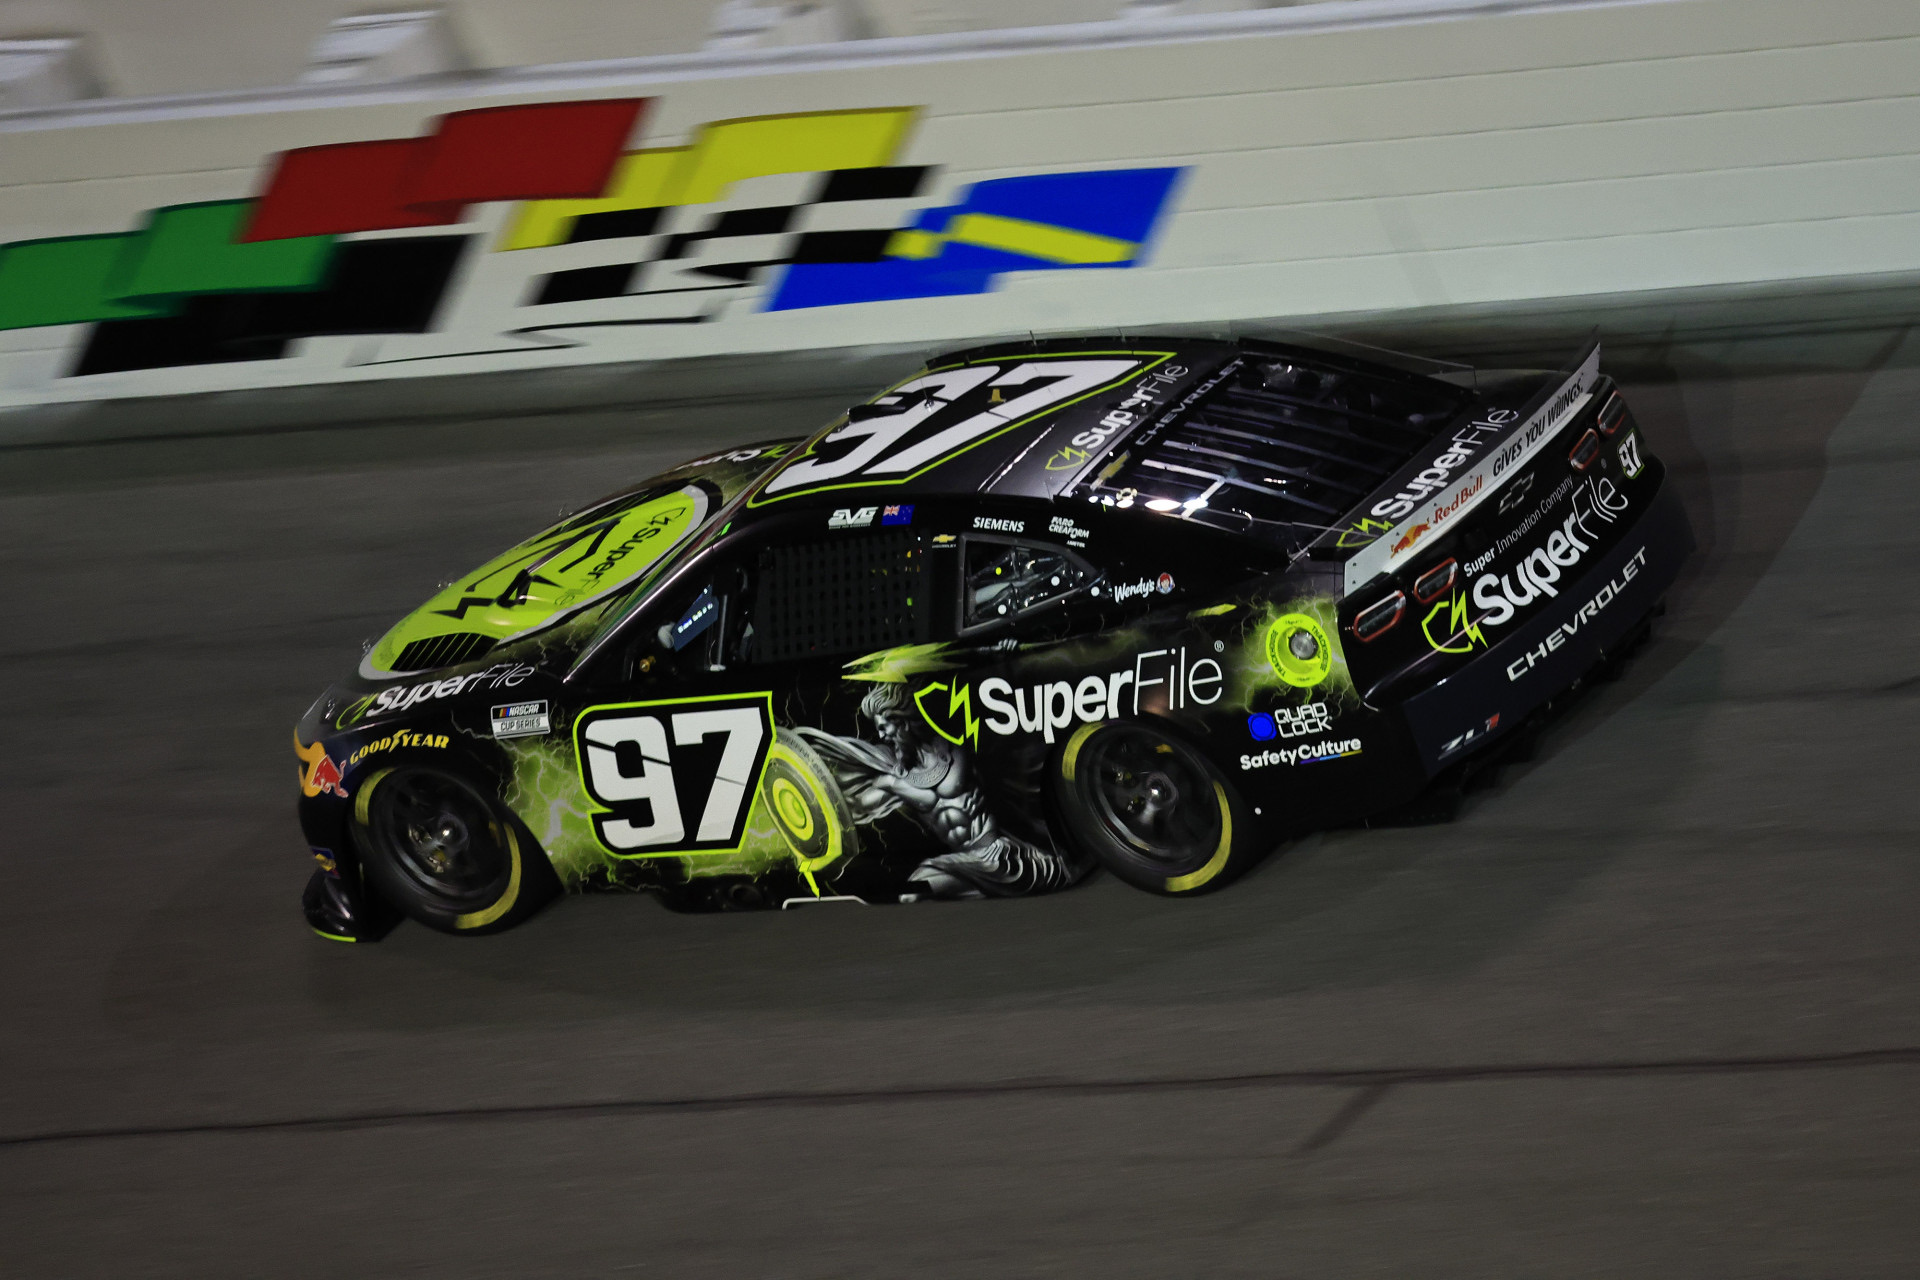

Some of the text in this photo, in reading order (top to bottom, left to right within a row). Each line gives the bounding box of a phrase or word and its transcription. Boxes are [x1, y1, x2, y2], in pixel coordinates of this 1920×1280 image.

[1072, 365, 1189, 449] SuperFile
[1135, 358, 1244, 446] CHEVROLET
[765, 360, 1143, 494] 97
[1371, 406, 1519, 519] SuperFile
[1433, 494, 1459, 523] Red
[1460, 475, 1483, 504] Bull
[1493, 437, 1523, 477] GIVES
[1525, 418, 1546, 448] YOU
[1618, 432, 1642, 477] 97
[828, 506, 879, 527] SVG
[972, 516, 1025, 533] SIEMENS
[1048, 523, 1090, 540] CREAFORM
[1051, 515, 1075, 528] FARO
[1463, 474, 1574, 578] Super Innovation Company
[1473, 475, 1629, 626] SuperFile
[1114, 577, 1155, 603] Wendy's
[1506, 546, 1647, 682] CHEVROLET
[365, 662, 536, 717] SuperFile
[509, 704, 540, 717] NASCAR
[978, 646, 1225, 744] SuperFile
[500, 717, 541, 732] CUP SERIES
[1274, 702, 1328, 724] QUAD
[1278, 715, 1333, 739] LOCK
[350, 728, 450, 766] GOODYEAR
[1240, 738, 1362, 770] SafetyCulture
[584, 707, 764, 849] 97
